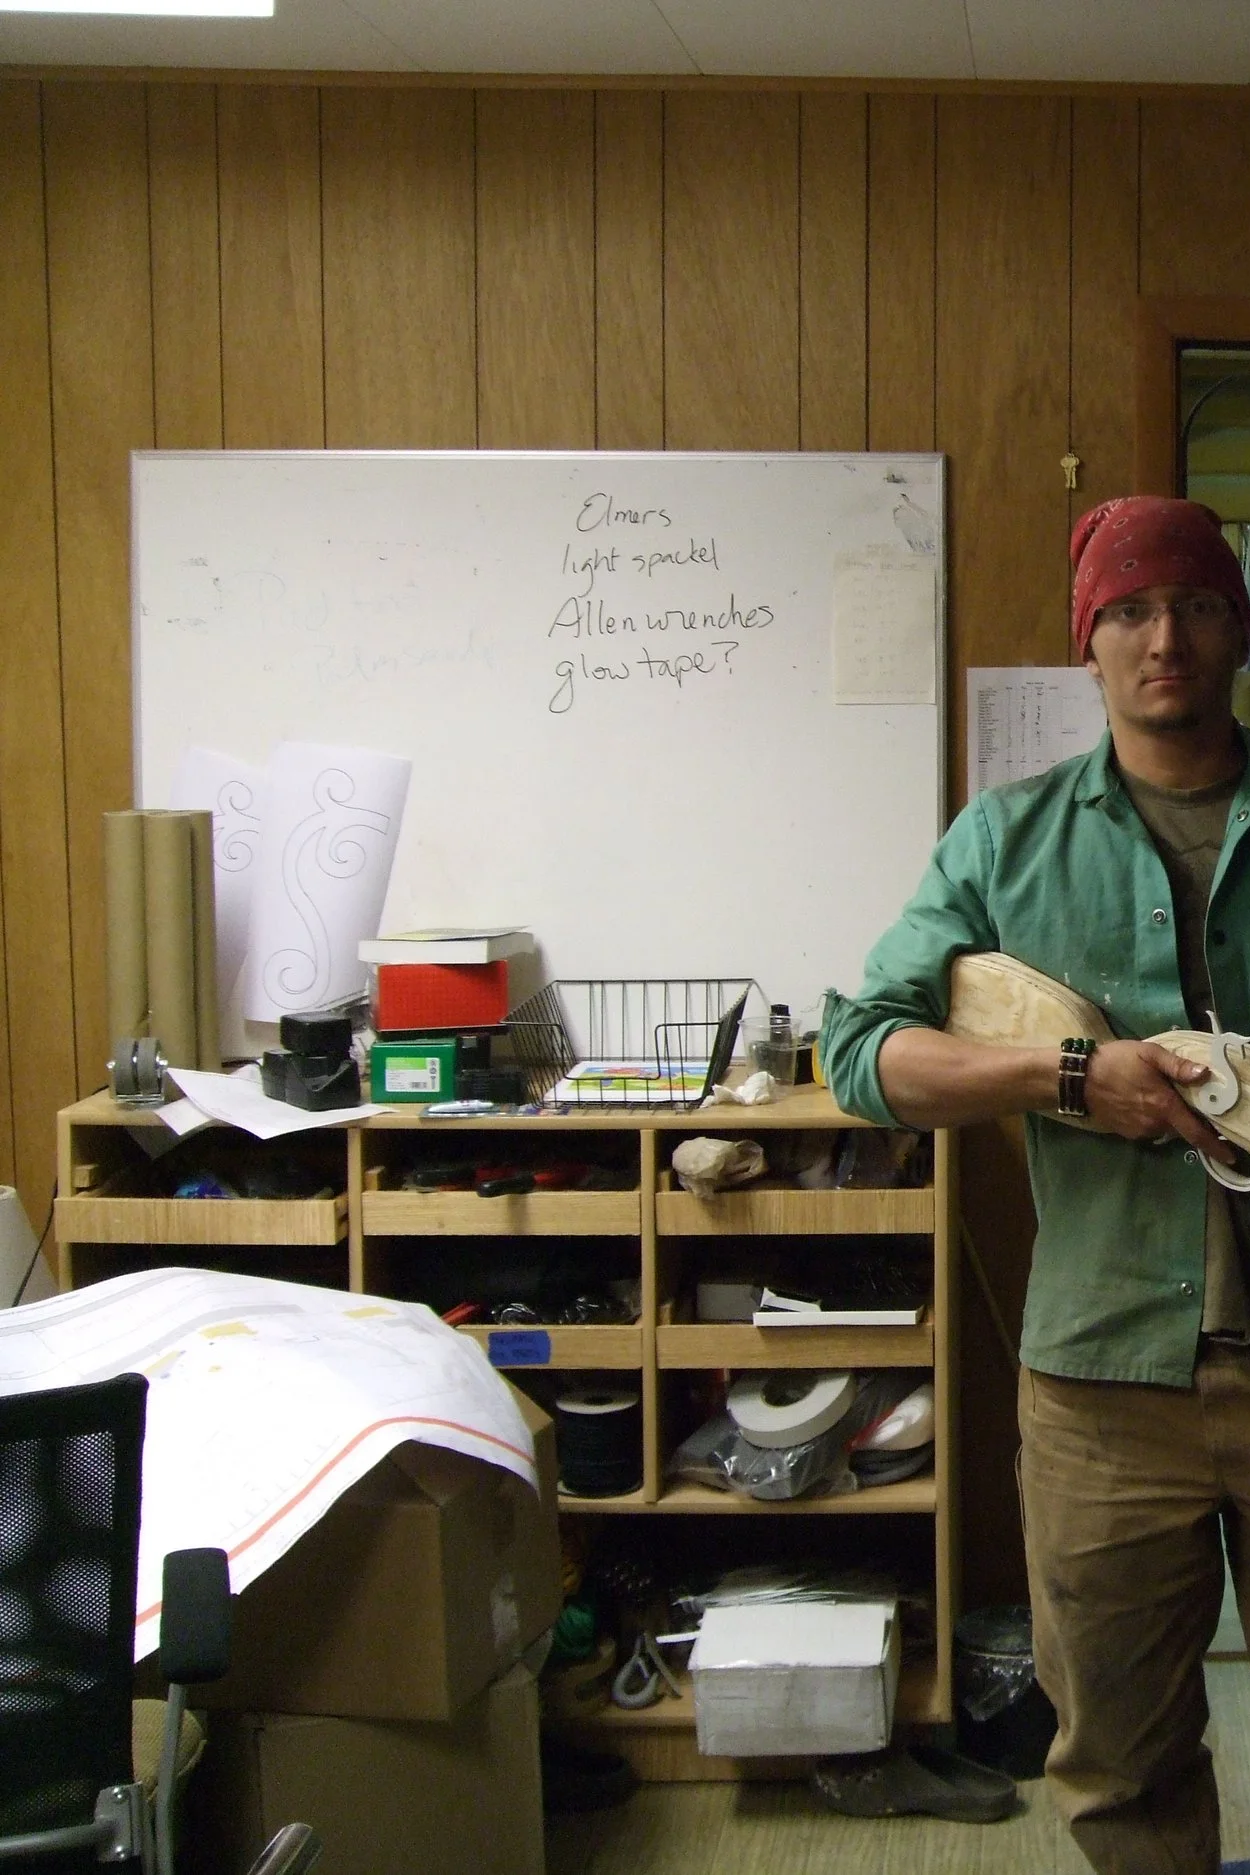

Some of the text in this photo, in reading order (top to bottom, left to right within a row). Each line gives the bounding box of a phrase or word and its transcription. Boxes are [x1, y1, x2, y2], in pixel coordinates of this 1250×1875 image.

[576, 493, 672, 532] Elmers
[562, 543, 620, 598] light
[548, 593, 774, 638] Allen wrenches
[548, 654, 630, 713] glow
[636, 641, 739, 688] tape?
